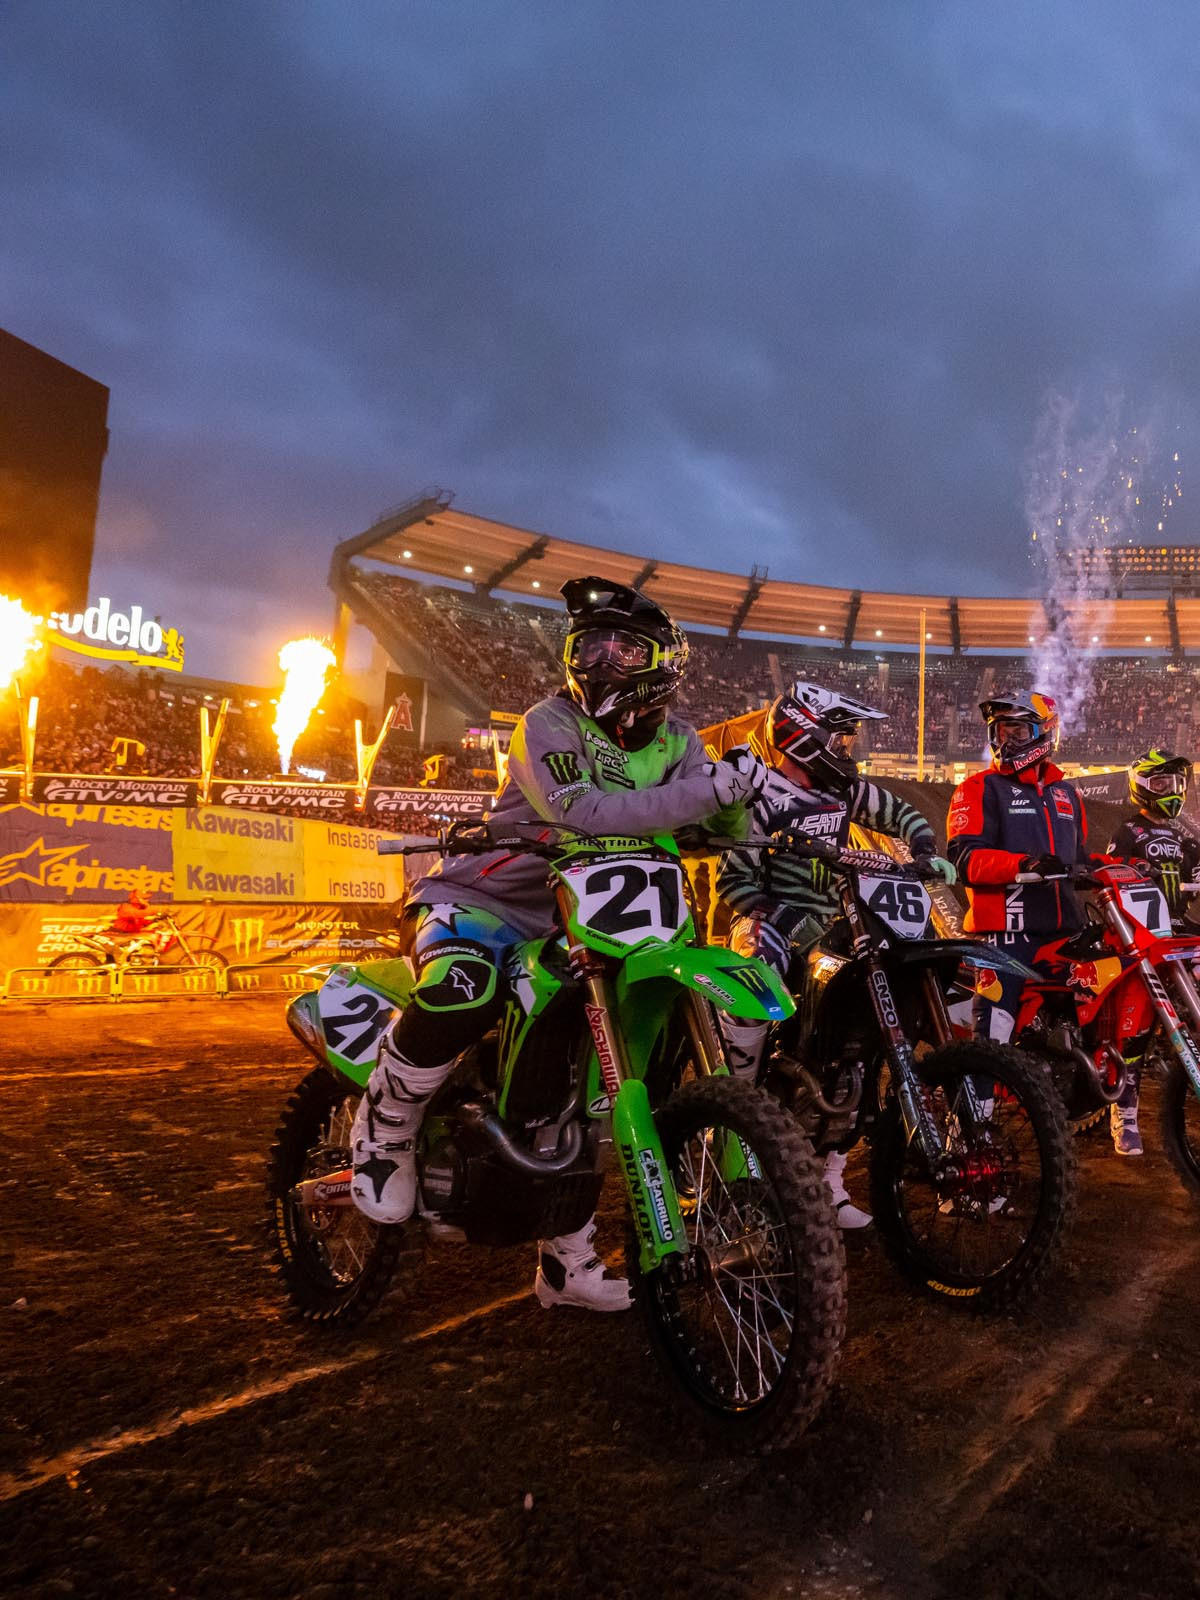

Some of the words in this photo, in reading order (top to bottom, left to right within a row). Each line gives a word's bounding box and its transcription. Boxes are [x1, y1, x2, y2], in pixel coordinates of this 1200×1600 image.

[47, 598, 163, 653] odelo
[68, 778, 115, 790] ROCKY
[115, 780, 189, 793] MOUNTAIN
[242, 784, 283, 795] ROCKY
[283, 786, 347, 798] MOUNTAIN
[392, 791, 428, 801] ROCKY
[428, 792, 485, 803] MOUNTAIN
[185, 807, 294, 842] Kawasaki
[47, 858, 174, 895] alpinestars
[186, 864, 295, 896] Kawasaki
[837, 856, 893, 872] RENTHAL
[329, 879, 386, 900] Insta360
[585, 864, 679, 936] 21
[868, 881, 925, 924] 46
[1130, 890, 1161, 930] 7
[418, 946, 485, 966] Kawasaki
[872, 970, 899, 1028] ENZO
[927, 1279, 976, 1297] DUNLOP
